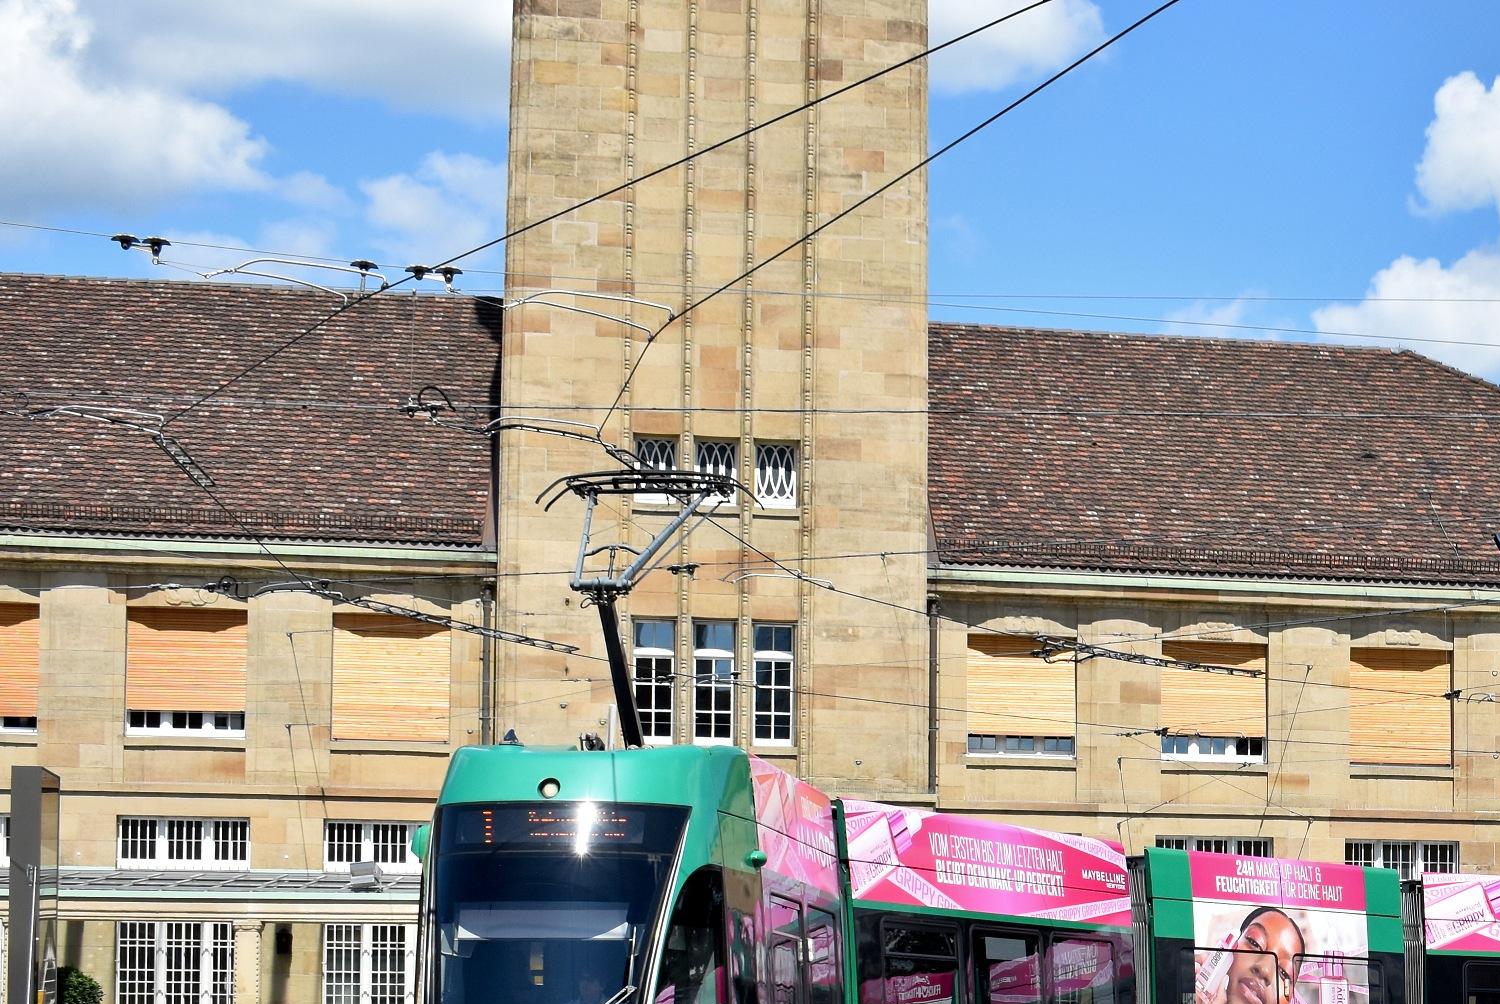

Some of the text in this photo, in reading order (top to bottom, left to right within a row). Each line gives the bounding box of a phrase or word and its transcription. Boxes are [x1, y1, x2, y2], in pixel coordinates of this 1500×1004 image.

[929, 832, 1065, 874] VOM ERSTEN BIS ZUM LETZTEN HALT,
[895, 868, 936, 905] GRIPPY
[936, 859, 966, 884] BLEIBT
[967, 864, 987, 888] DEIN
[1026, 872, 1065, 897] PERFEKT!
[1082, 869, 1125, 884] MAYBELLINE
[1236, 860, 1255, 876] 24H
[1293, 865, 1313, 881] HALT
[1315, 867, 1321, 882] &
[1216, 876, 1343, 902] FEUCHTIGKEIT FÜR DEINE HAUT
